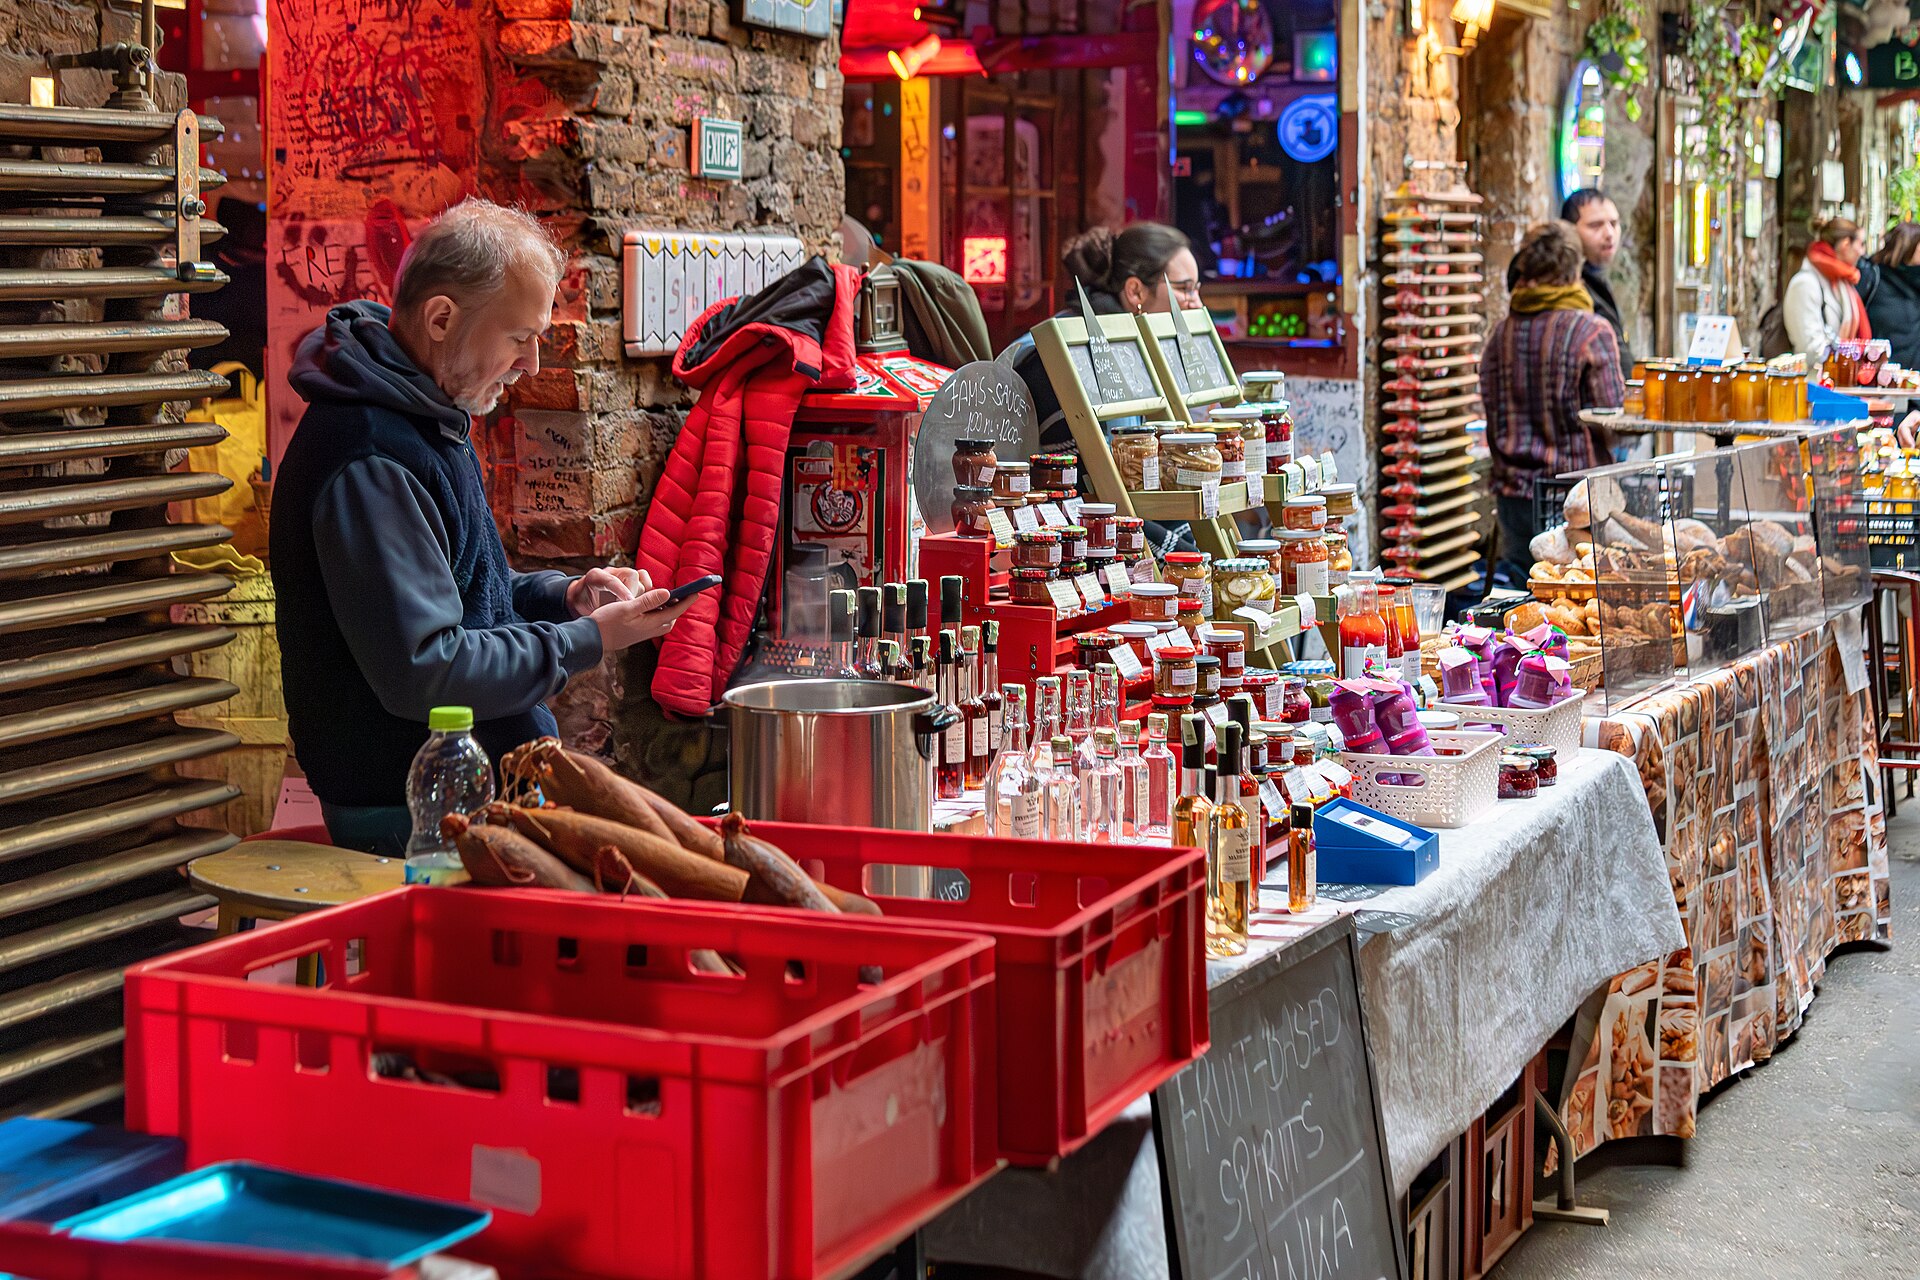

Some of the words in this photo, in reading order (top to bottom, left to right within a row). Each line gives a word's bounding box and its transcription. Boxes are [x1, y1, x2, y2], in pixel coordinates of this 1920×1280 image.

[706, 130, 726, 166] EXIT
[938, 881, 965, 902] HOT
[1170, 987, 1342, 1170] FRUIT-BASED
[1219, 1099, 1325, 1242] SPIRITS
